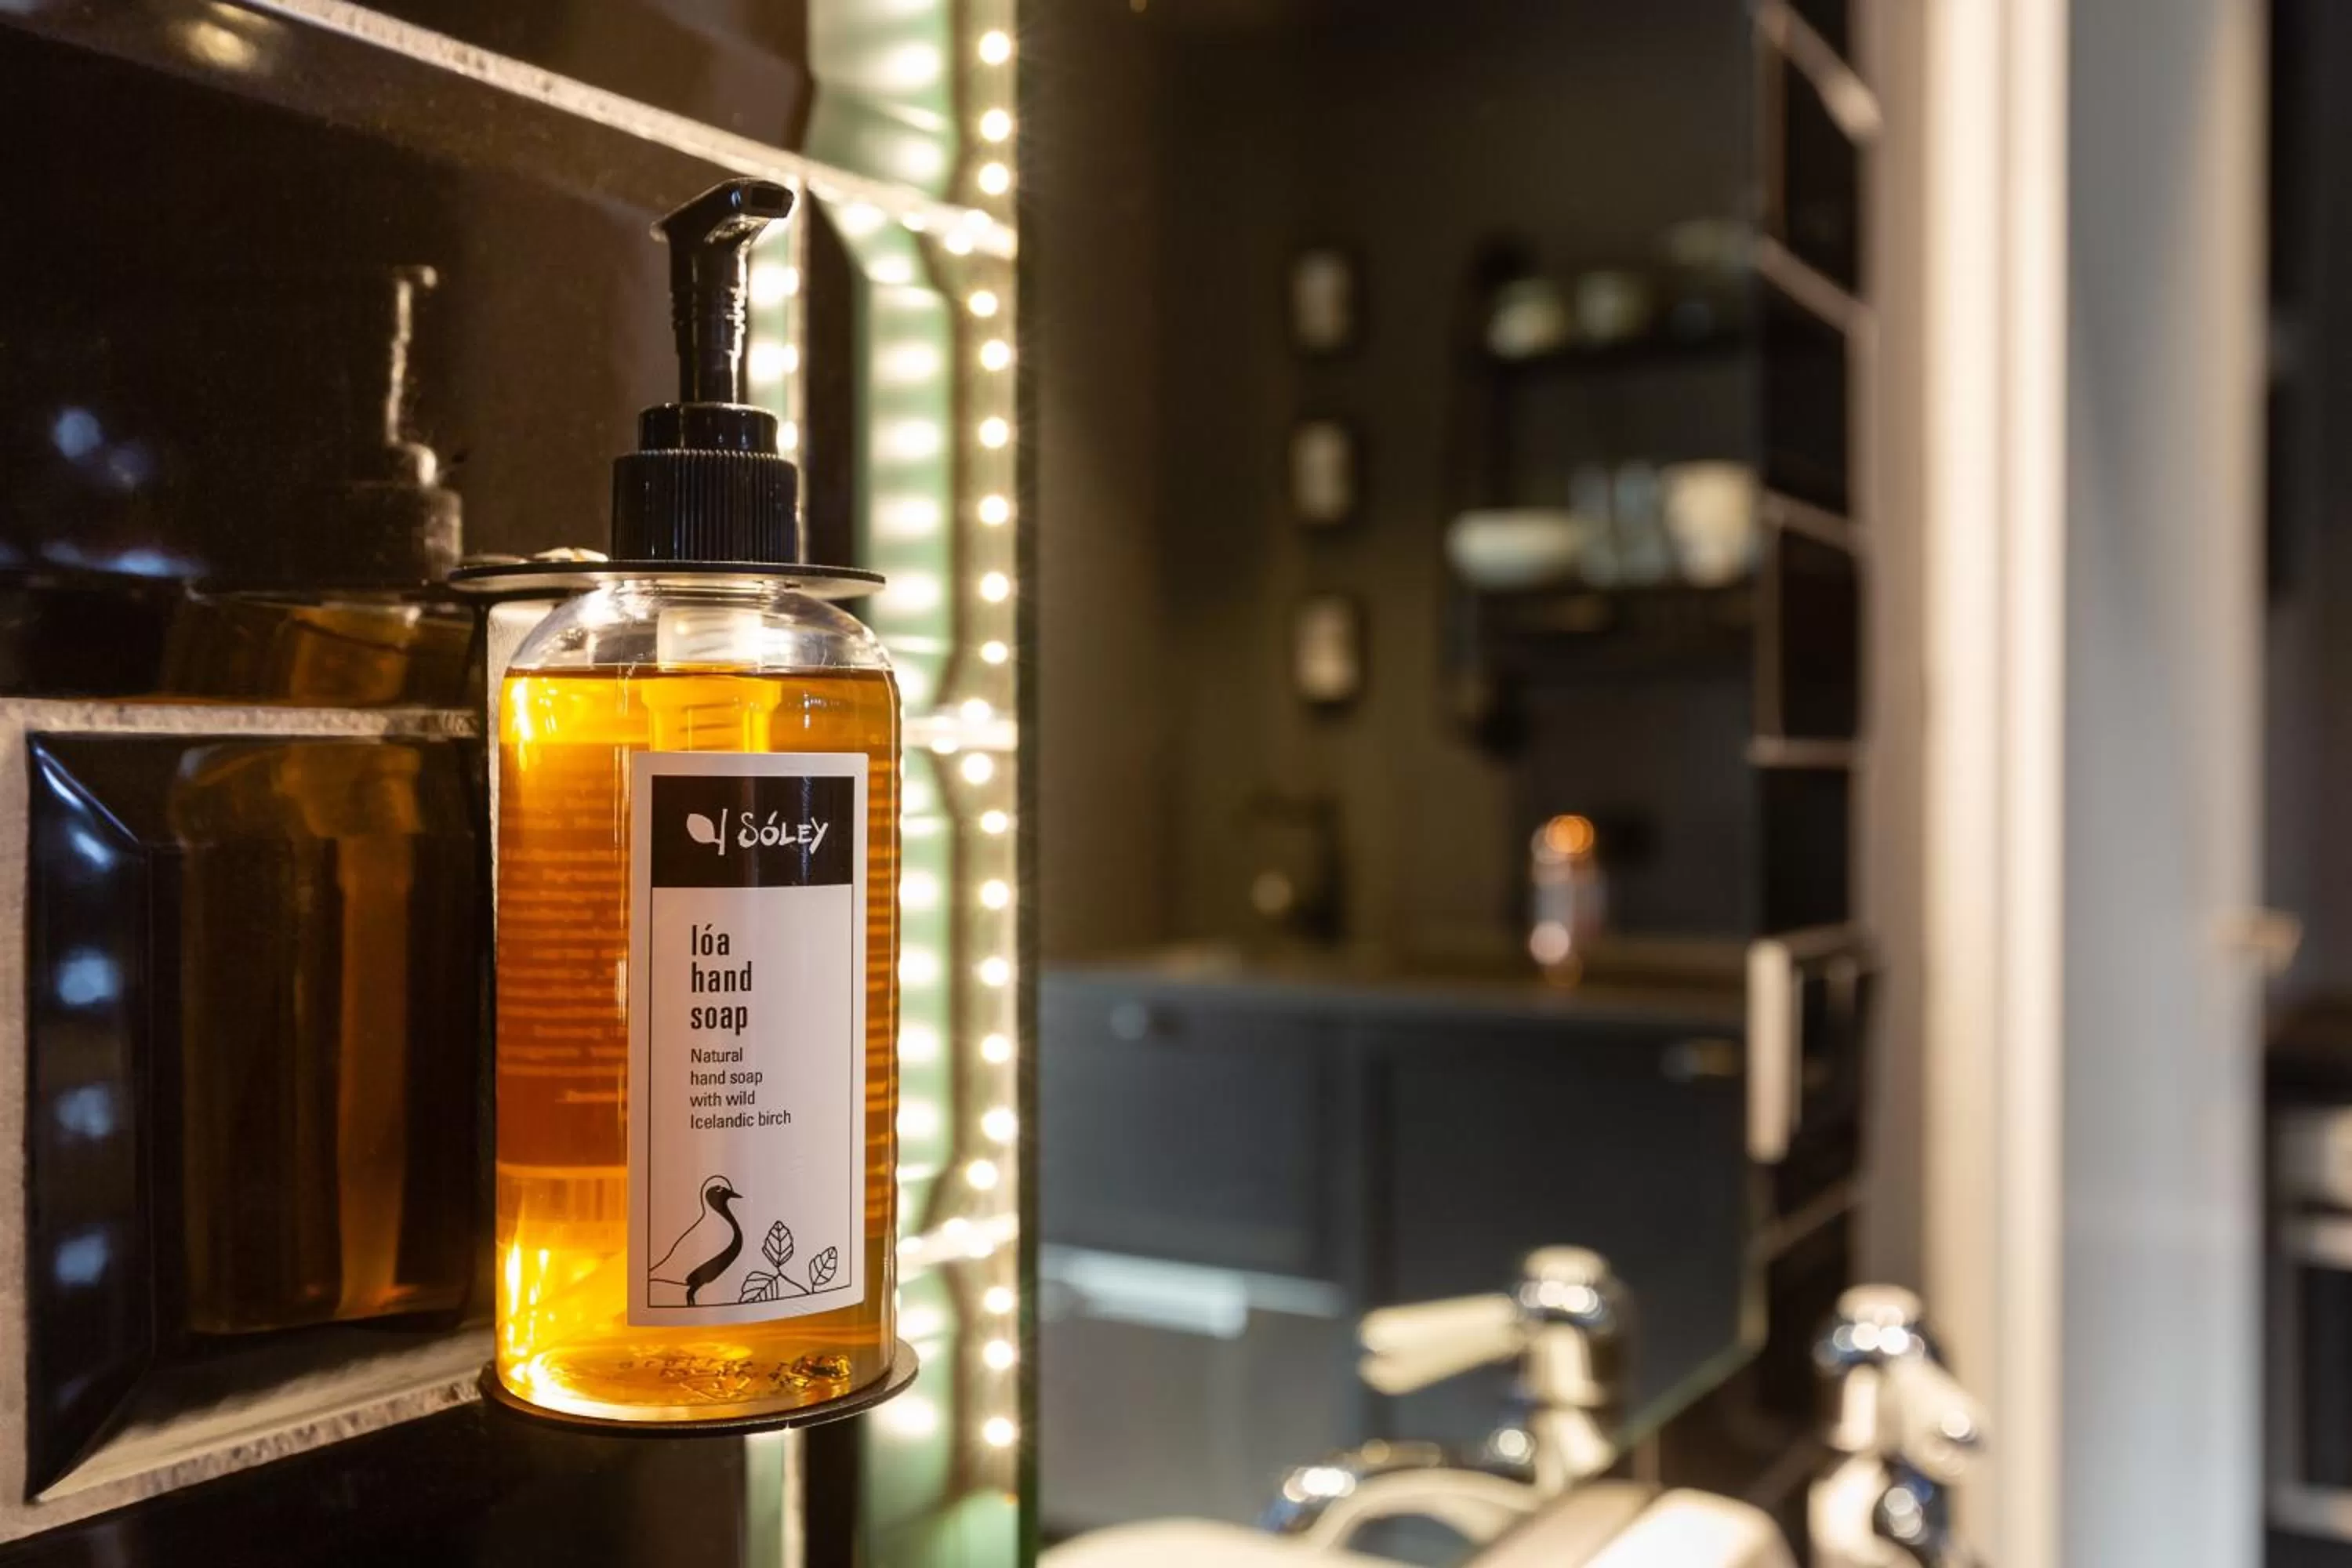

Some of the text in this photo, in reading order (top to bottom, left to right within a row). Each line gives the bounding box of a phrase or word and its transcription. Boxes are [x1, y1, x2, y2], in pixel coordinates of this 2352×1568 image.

[691, 924, 730, 956] lóa
[691, 961, 753, 993] hand
[691, 1006, 748, 1036] soap
[691, 1047, 743, 1063] Natural
[690, 1070, 763, 1086] hand soap
[690, 1090, 756, 1108] with wild
[690, 1109, 791, 1130] Icelandic birch
